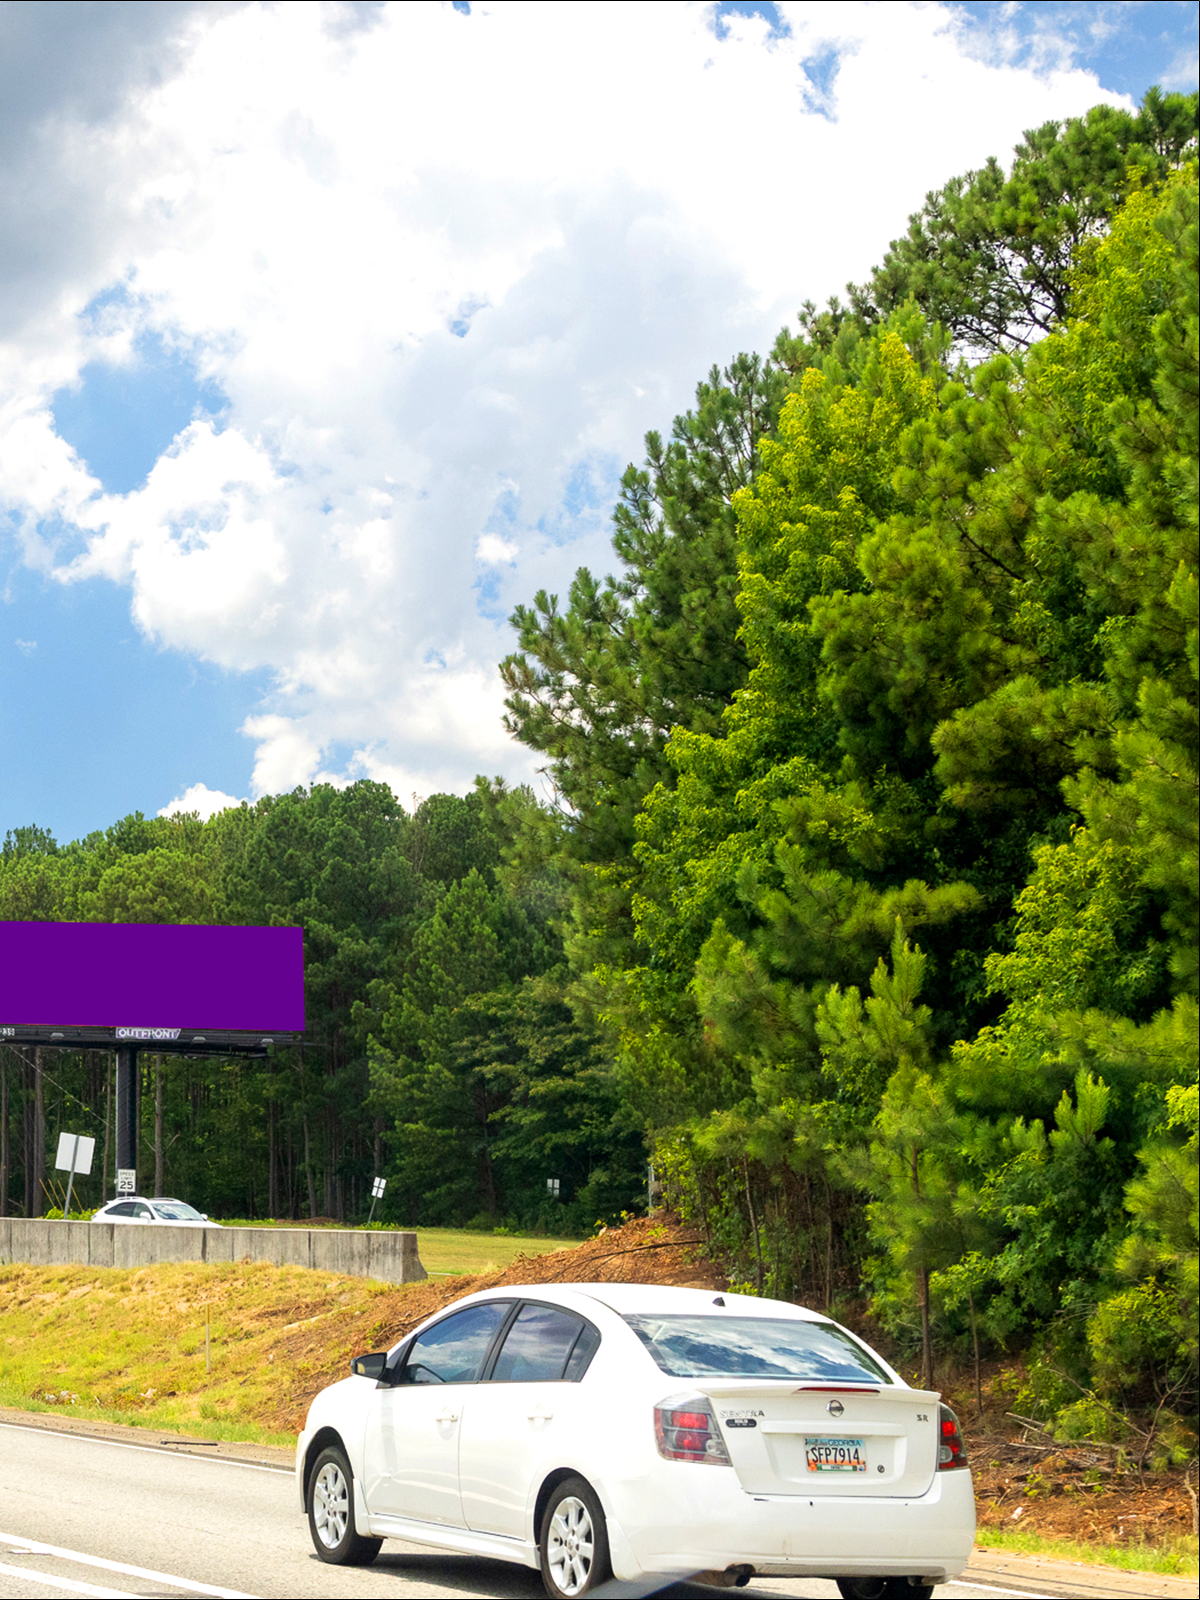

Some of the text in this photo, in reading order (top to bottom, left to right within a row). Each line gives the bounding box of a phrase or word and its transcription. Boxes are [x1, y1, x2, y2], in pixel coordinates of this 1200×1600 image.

[118, 1028, 176, 1039] OUTFRONT
[120, 1180, 134, 1190] 25
[720, 1410, 765, 1418] SENTRA
[916, 1414, 929, 1422] SR
[827, 1439, 861, 1447] GEORGIA
[810, 1447, 860, 1465] SFP7914
